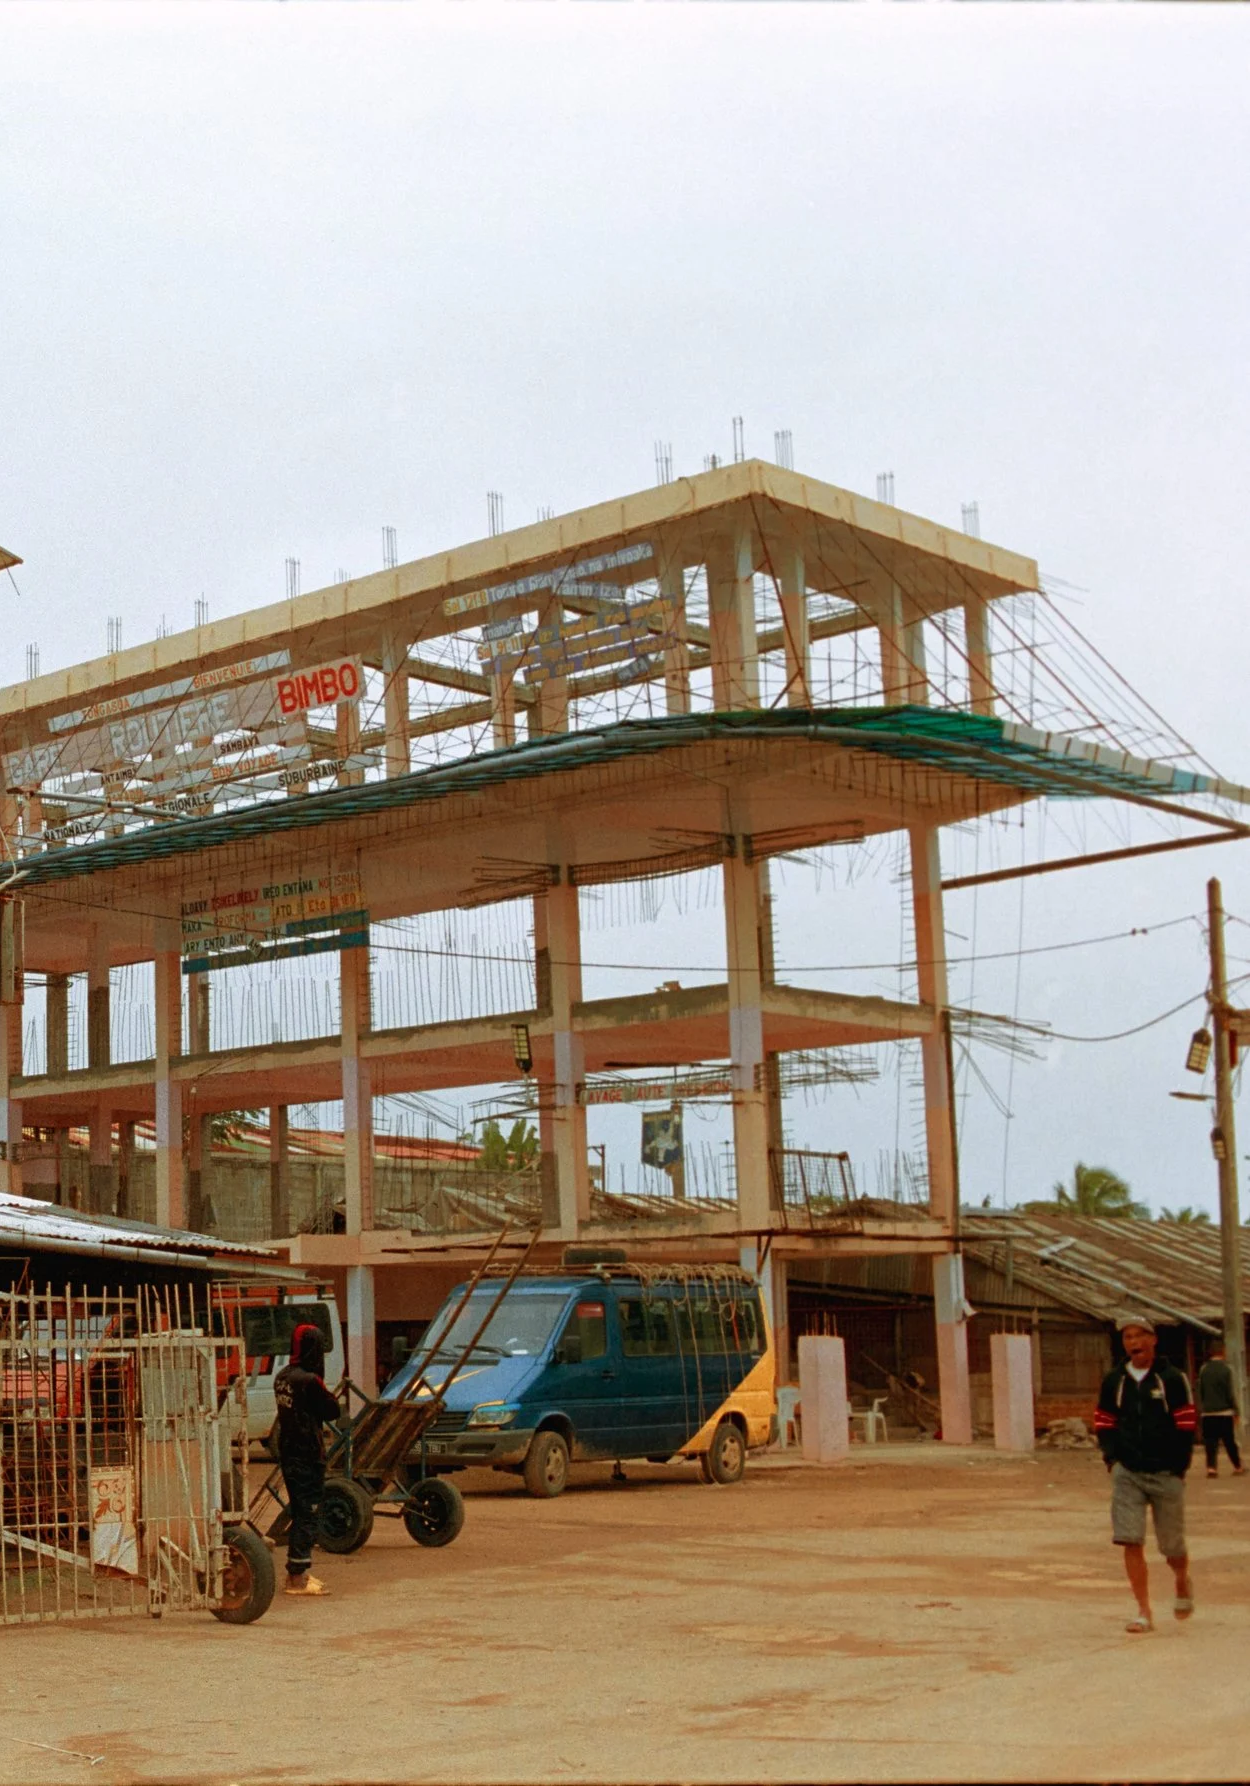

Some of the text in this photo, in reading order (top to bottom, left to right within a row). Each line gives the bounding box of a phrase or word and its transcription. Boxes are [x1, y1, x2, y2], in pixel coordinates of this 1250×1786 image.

[193, 661, 256, 688] BIENVENUE
[8, 663, 359, 786] GARE ROUTIERE BIMBO
[278, 760, 345, 787] SUBURBAINE
